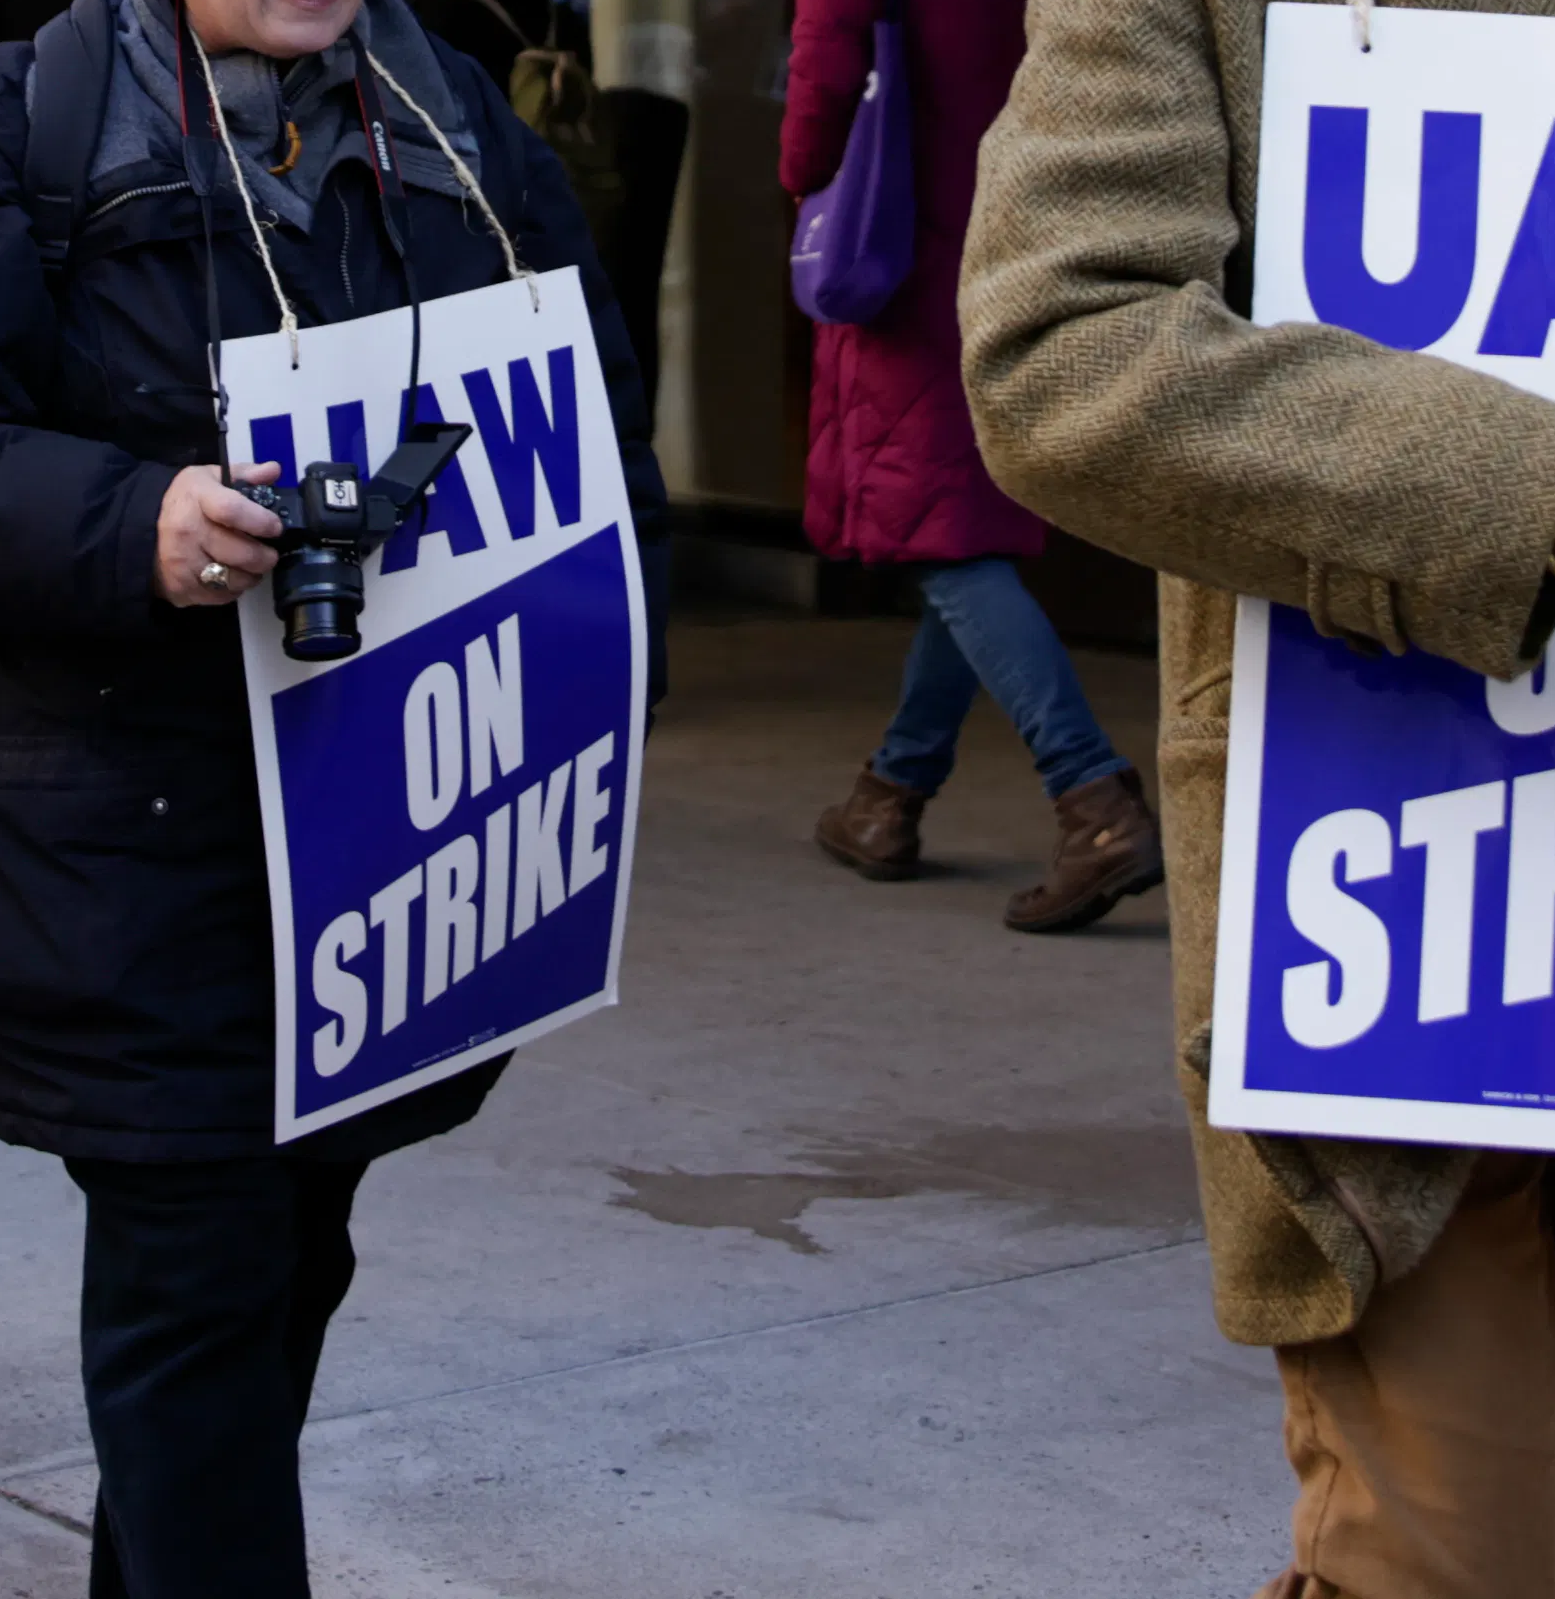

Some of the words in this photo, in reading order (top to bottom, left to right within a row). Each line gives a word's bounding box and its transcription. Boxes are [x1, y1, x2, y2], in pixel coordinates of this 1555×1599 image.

[372, 121, 391, 171] Canon
[403, 613, 525, 832] ON
[312, 730, 616, 1079] STRIKE
